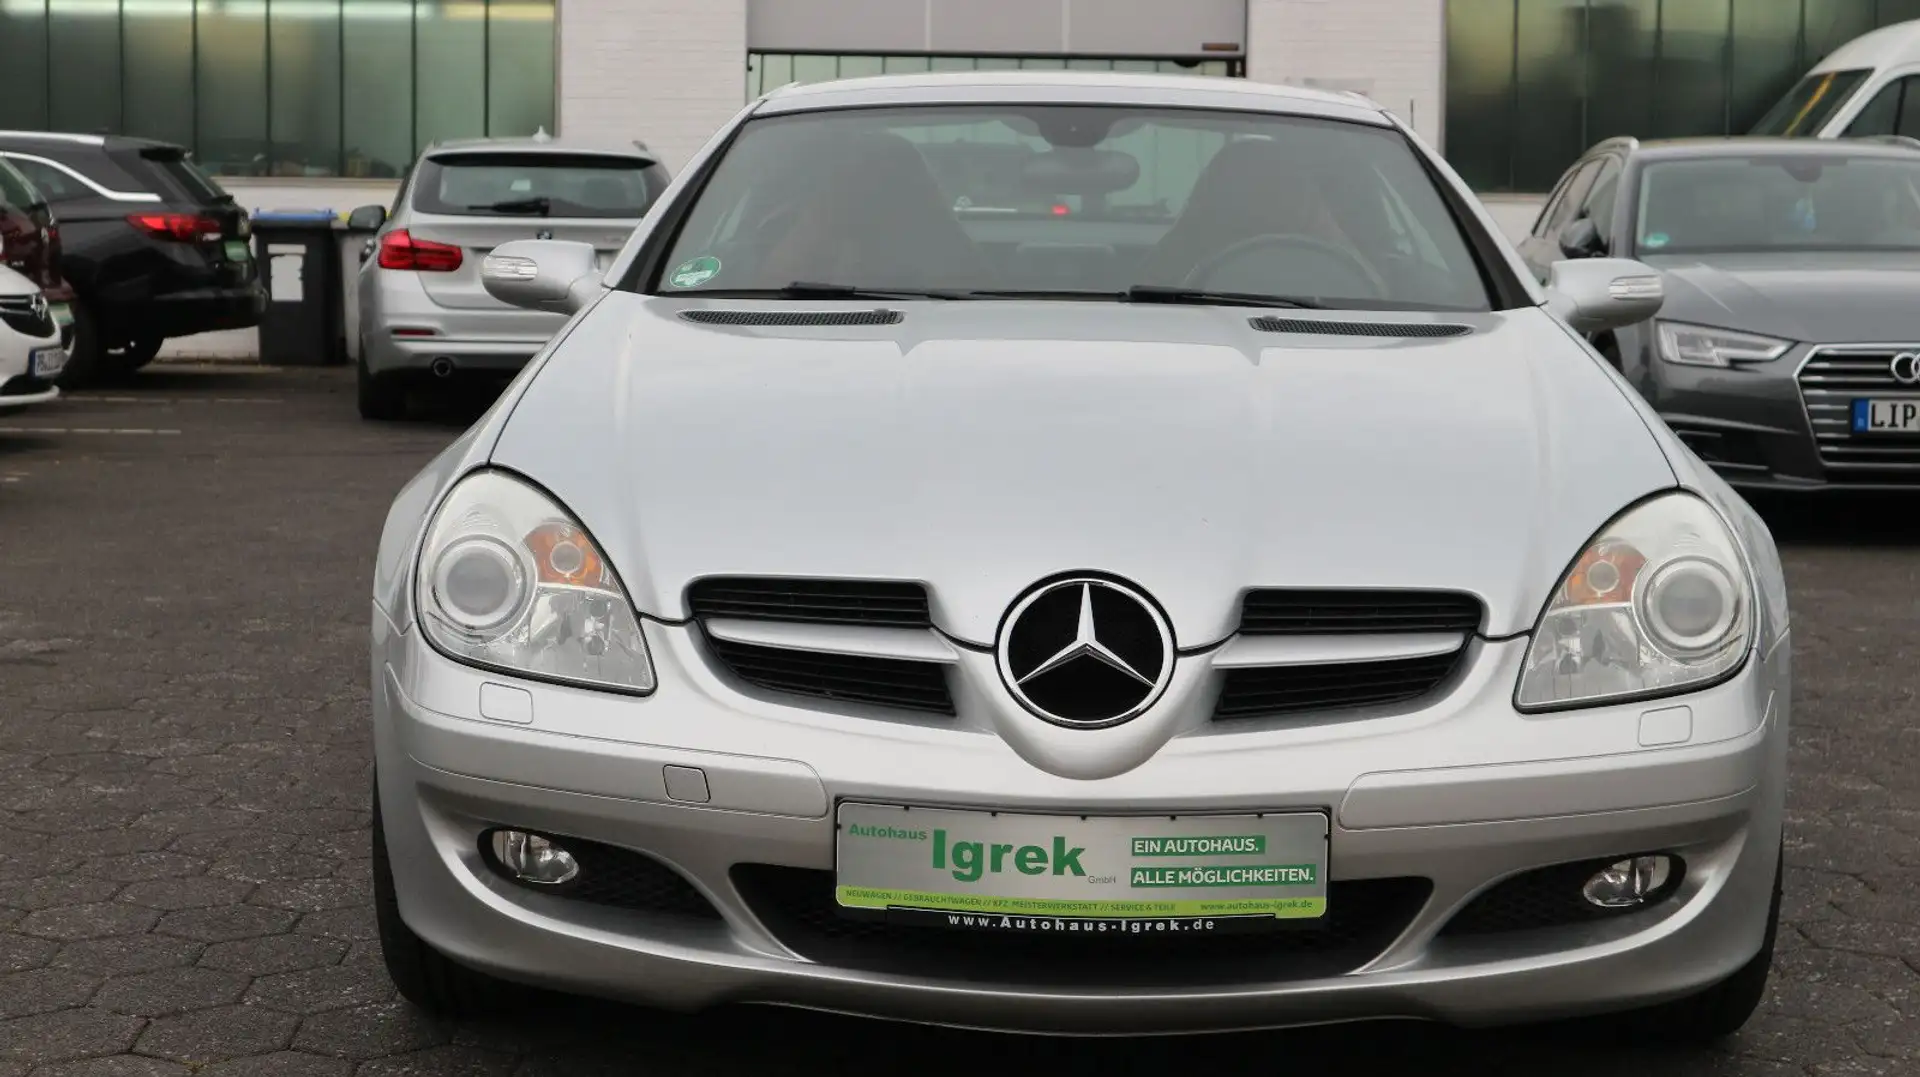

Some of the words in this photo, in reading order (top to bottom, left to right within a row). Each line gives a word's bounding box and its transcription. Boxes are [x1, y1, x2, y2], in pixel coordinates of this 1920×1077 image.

[1871, 403, 1916, 428] LIP
[849, 823, 927, 840] Autohaus
[1134, 840, 1160, 853] EIN
[1164, 838, 1259, 853] AUTOHAUS.
[932, 829, 1087, 882] Igrek
[1088, 875, 1116, 884] GmbH
[1133, 871, 1175, 884] ALLE
[1178, 867, 1314, 884] MÖGLICHKEITEN.
[846, 889, 892, 900] NEUWAGEN
[903, 894, 982, 906] GEBRAUCHTWAGEN
[1011, 901, 1098, 910] MEISTERWERKSTATT
[1110, 903, 1144, 912] SERVICE
[1200, 900, 1313, 911] www.autohaus-igrek.de
[948, 914, 1215, 933] www.Autohaus-Igrek.de
